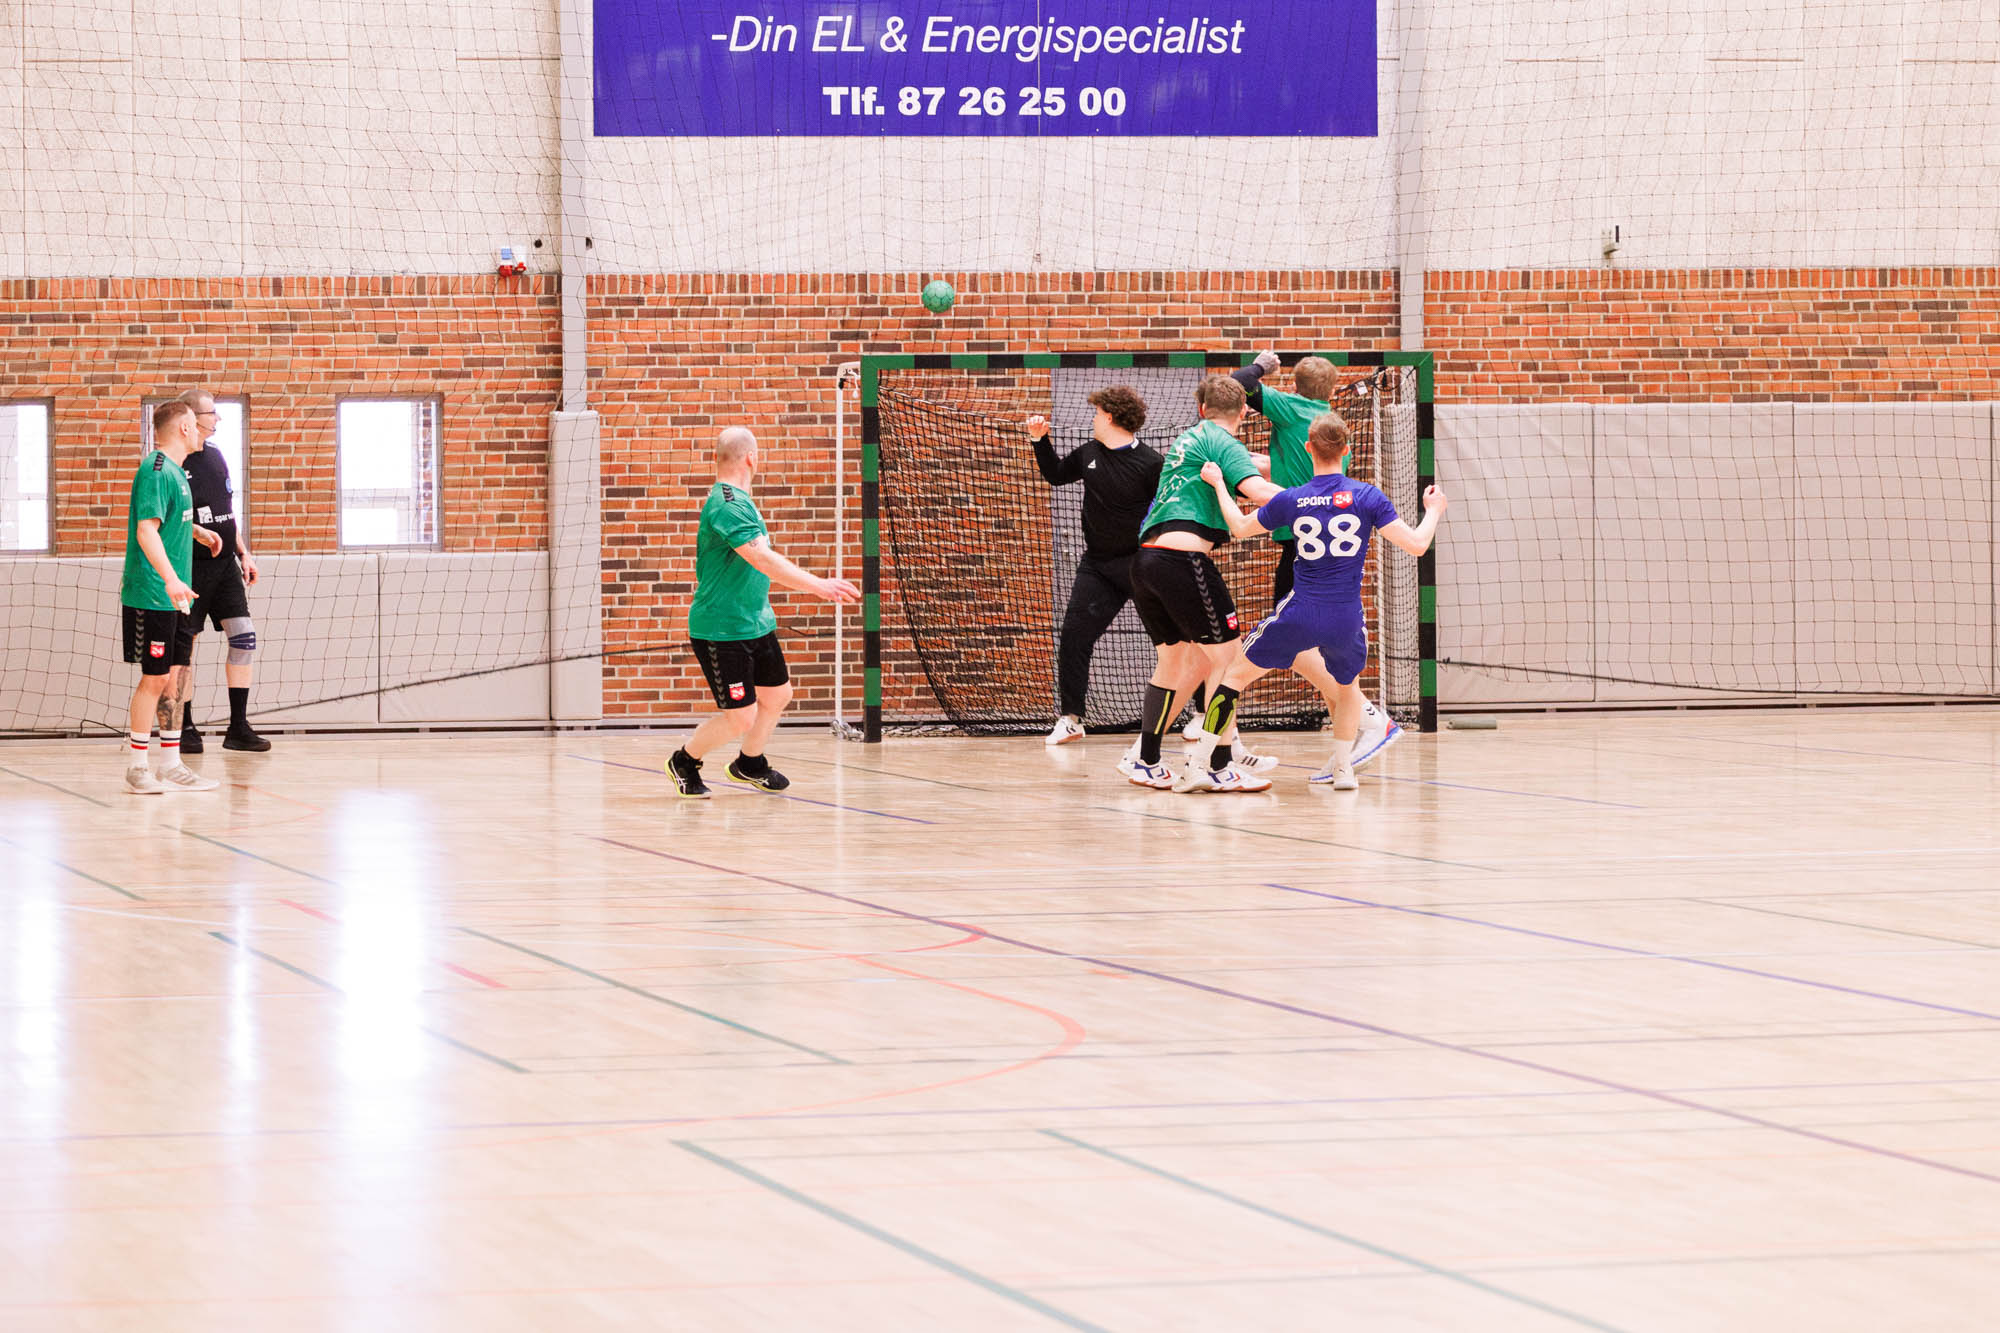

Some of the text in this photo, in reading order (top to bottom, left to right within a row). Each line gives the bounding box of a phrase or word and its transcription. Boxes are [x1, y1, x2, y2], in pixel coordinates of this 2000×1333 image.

[711, 14, 1246, 63] -Din EL & Energispecialist
[822, 86, 1126, 117] Tlf. 87 26 25 00
[1297, 494, 1352, 508] SPORT 24
[1293, 513, 1362, 560] 88
